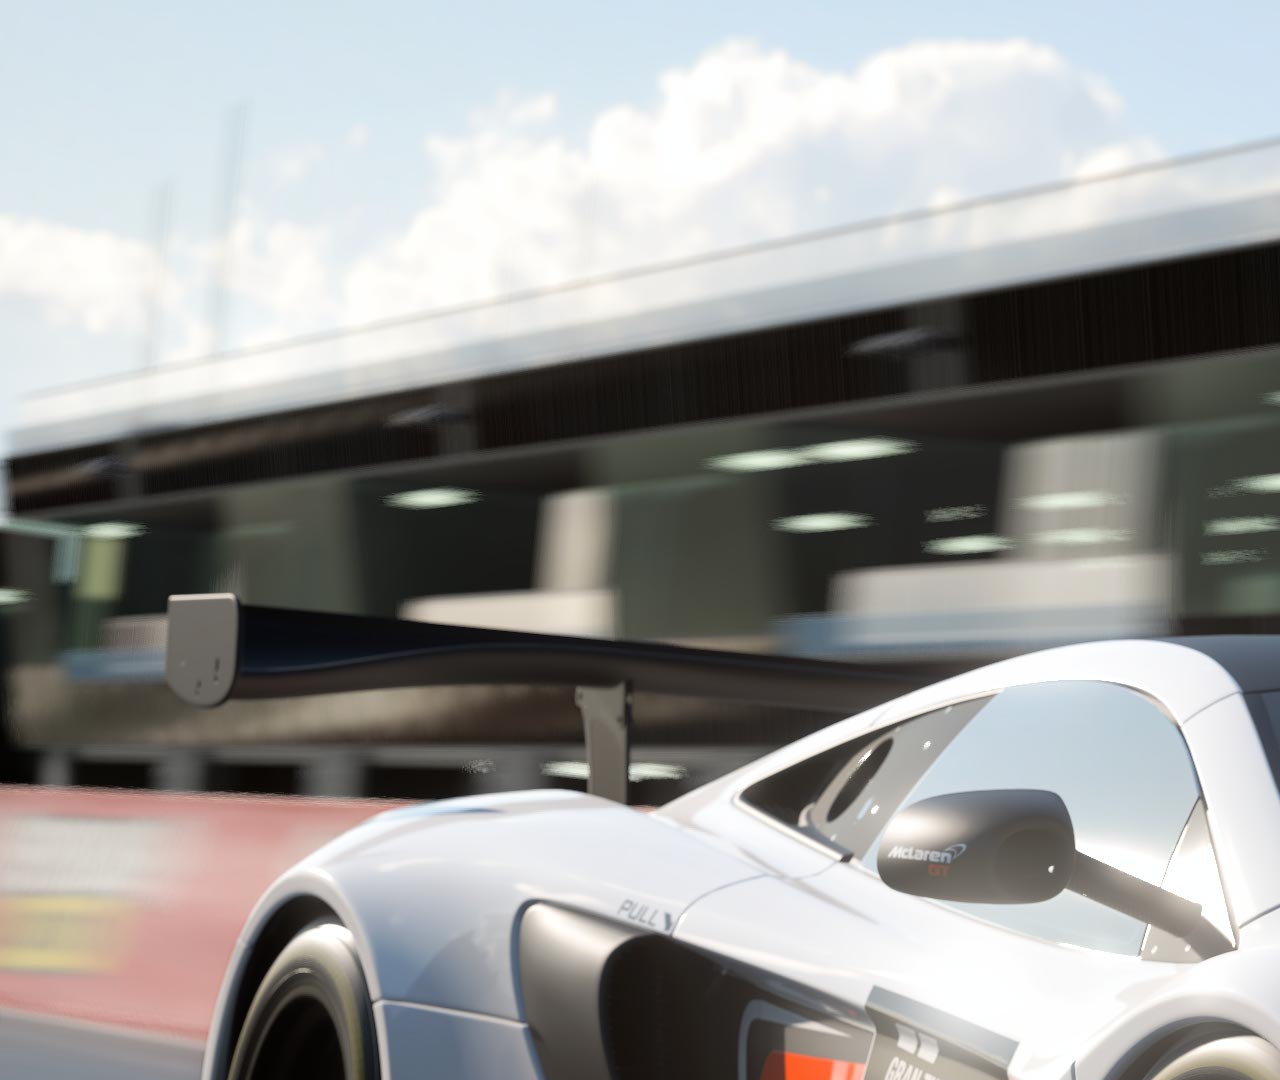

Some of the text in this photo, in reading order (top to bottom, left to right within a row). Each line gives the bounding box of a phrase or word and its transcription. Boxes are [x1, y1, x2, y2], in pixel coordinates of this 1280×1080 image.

[888, 846, 953, 864] McLaren
[928, 863, 952, 877] GT
[617, 899, 658, 926] PULL
